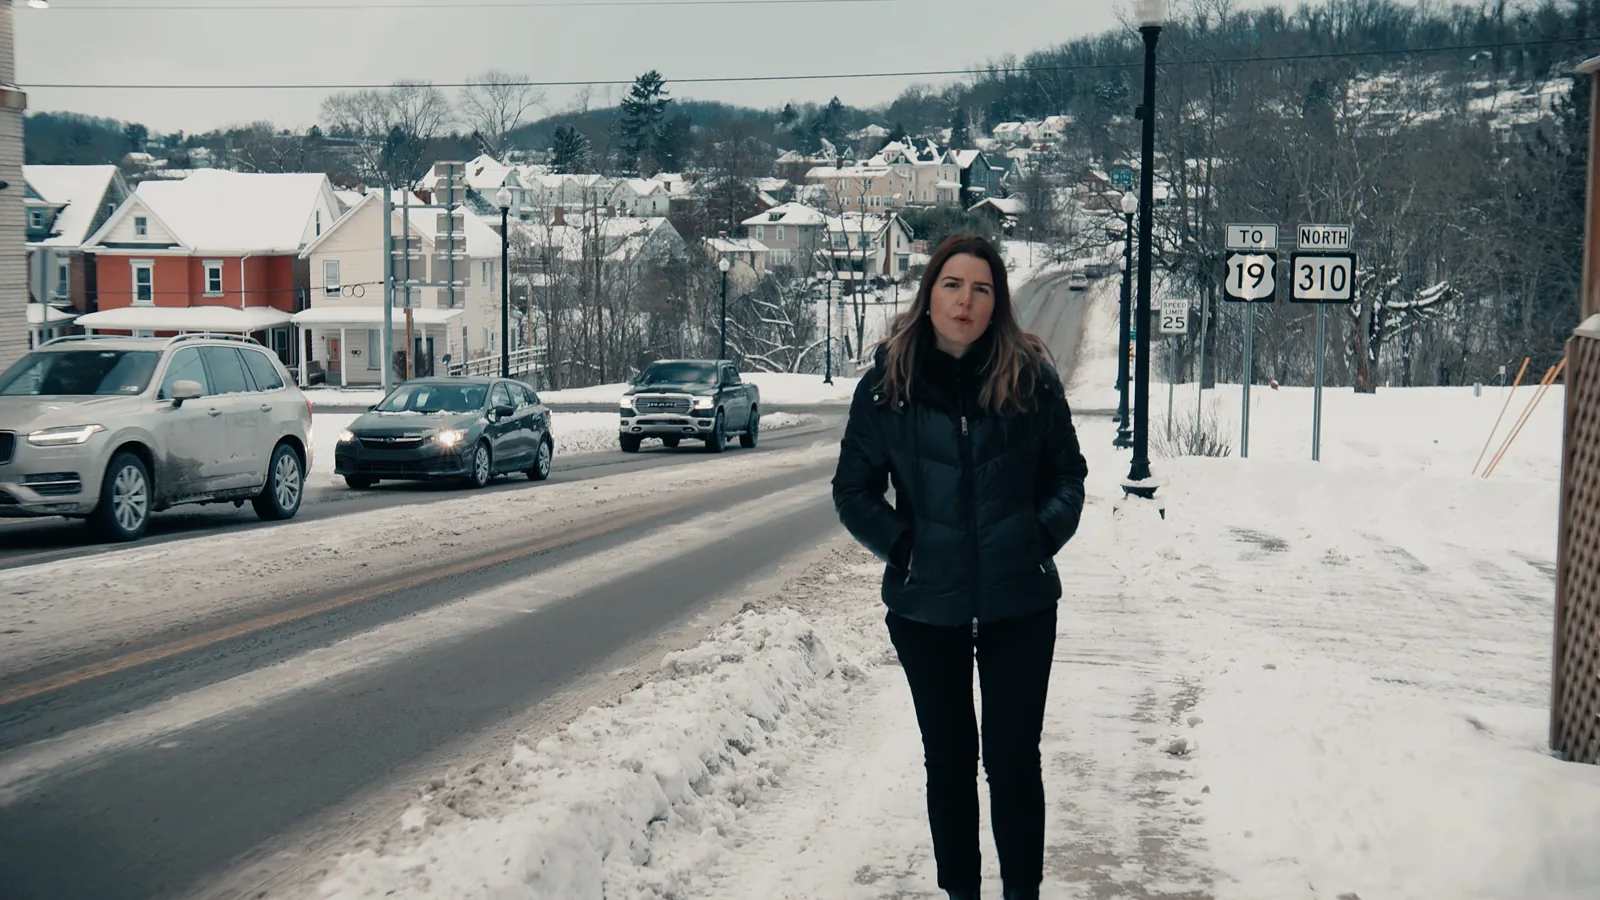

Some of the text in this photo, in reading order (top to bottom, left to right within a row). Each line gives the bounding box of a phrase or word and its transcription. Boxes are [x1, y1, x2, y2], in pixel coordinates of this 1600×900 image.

[1240, 230, 1263, 244] TO
[1301, 229, 1347, 244] NORTH
[1236, 263, 1265, 289] 19
[1299, 264, 1346, 292] 310
[1163, 316, 1185, 329] 25
